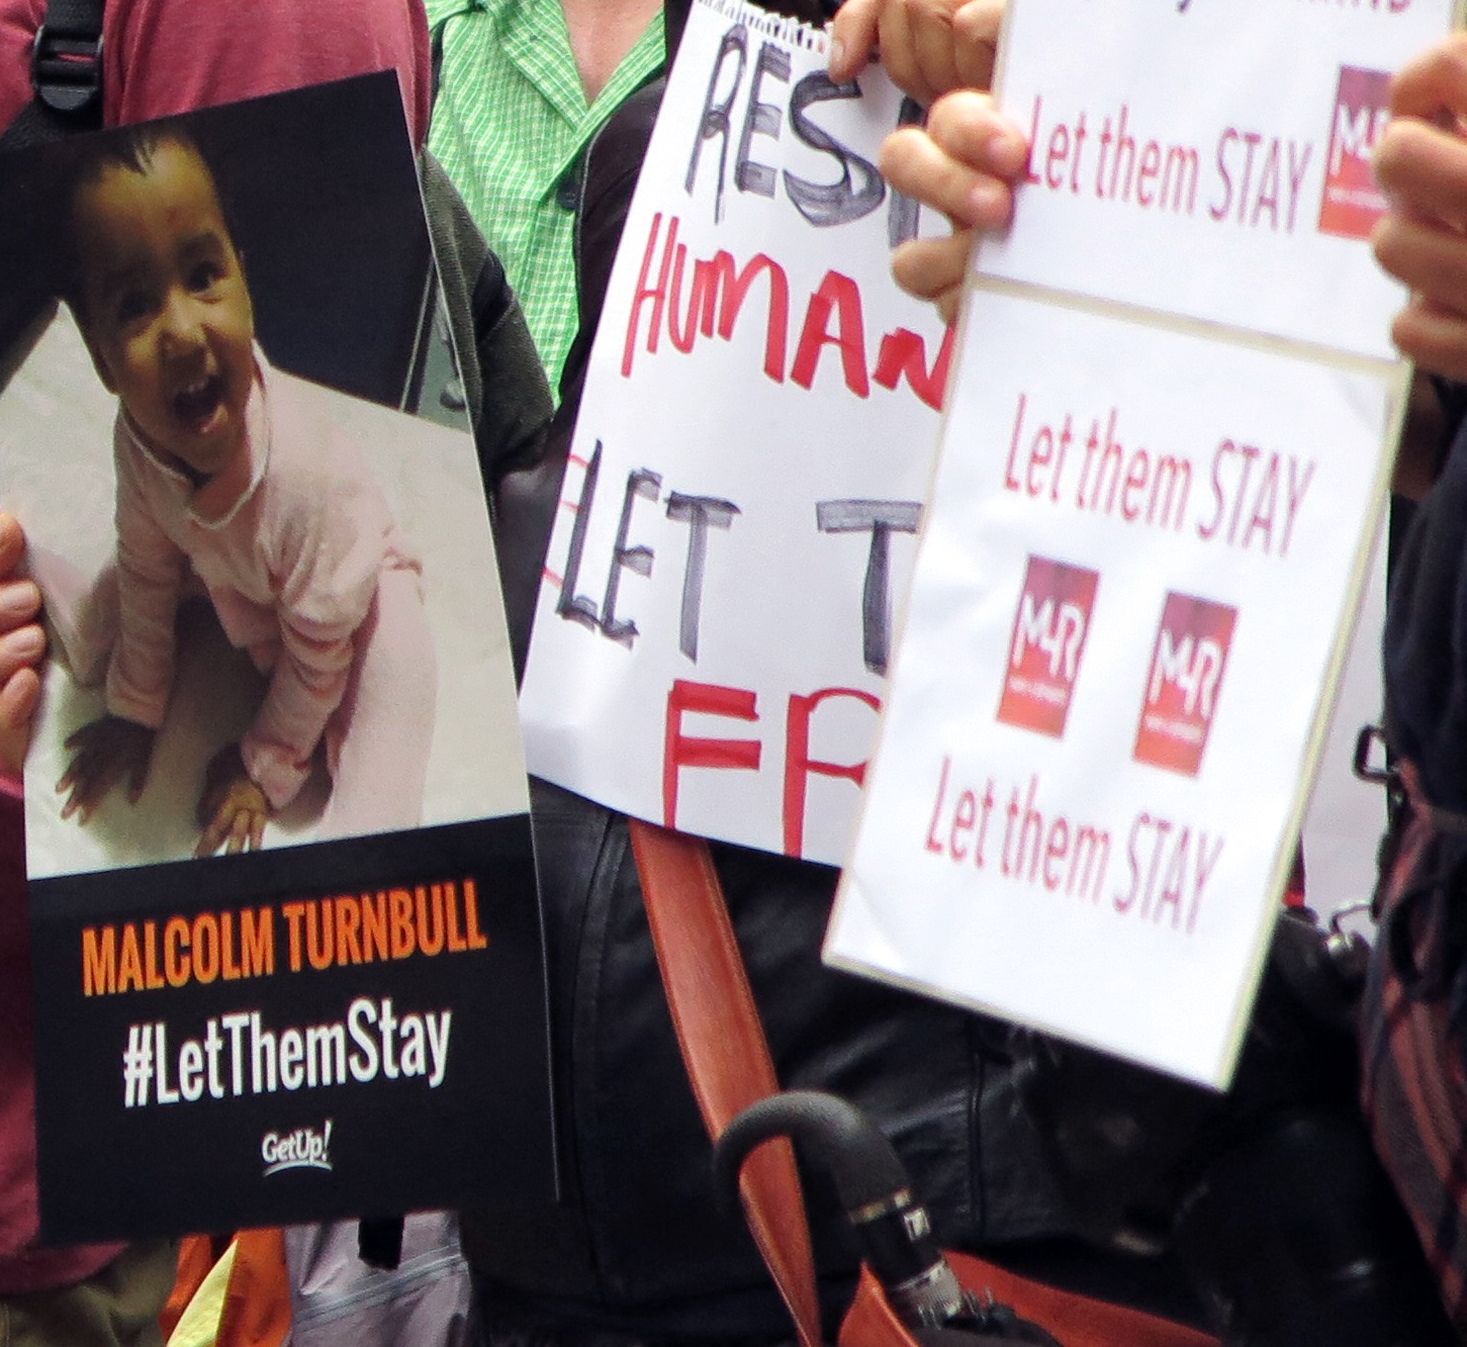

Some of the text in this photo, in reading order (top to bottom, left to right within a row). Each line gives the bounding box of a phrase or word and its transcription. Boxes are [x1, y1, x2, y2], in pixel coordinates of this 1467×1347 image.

[1025, 94, 1313, 233] Let them STAY
[1002, 392, 1317, 557] Let them STAY
[555, 440, 742, 664] LET
[924, 755, 1225, 935] Let them STAY
[81, 877, 488, 997] MALCOLM TURNBULL
[122, 997, 453, 1109] #LetThemStay
[261, 1120, 332, 1163] GetUp!
